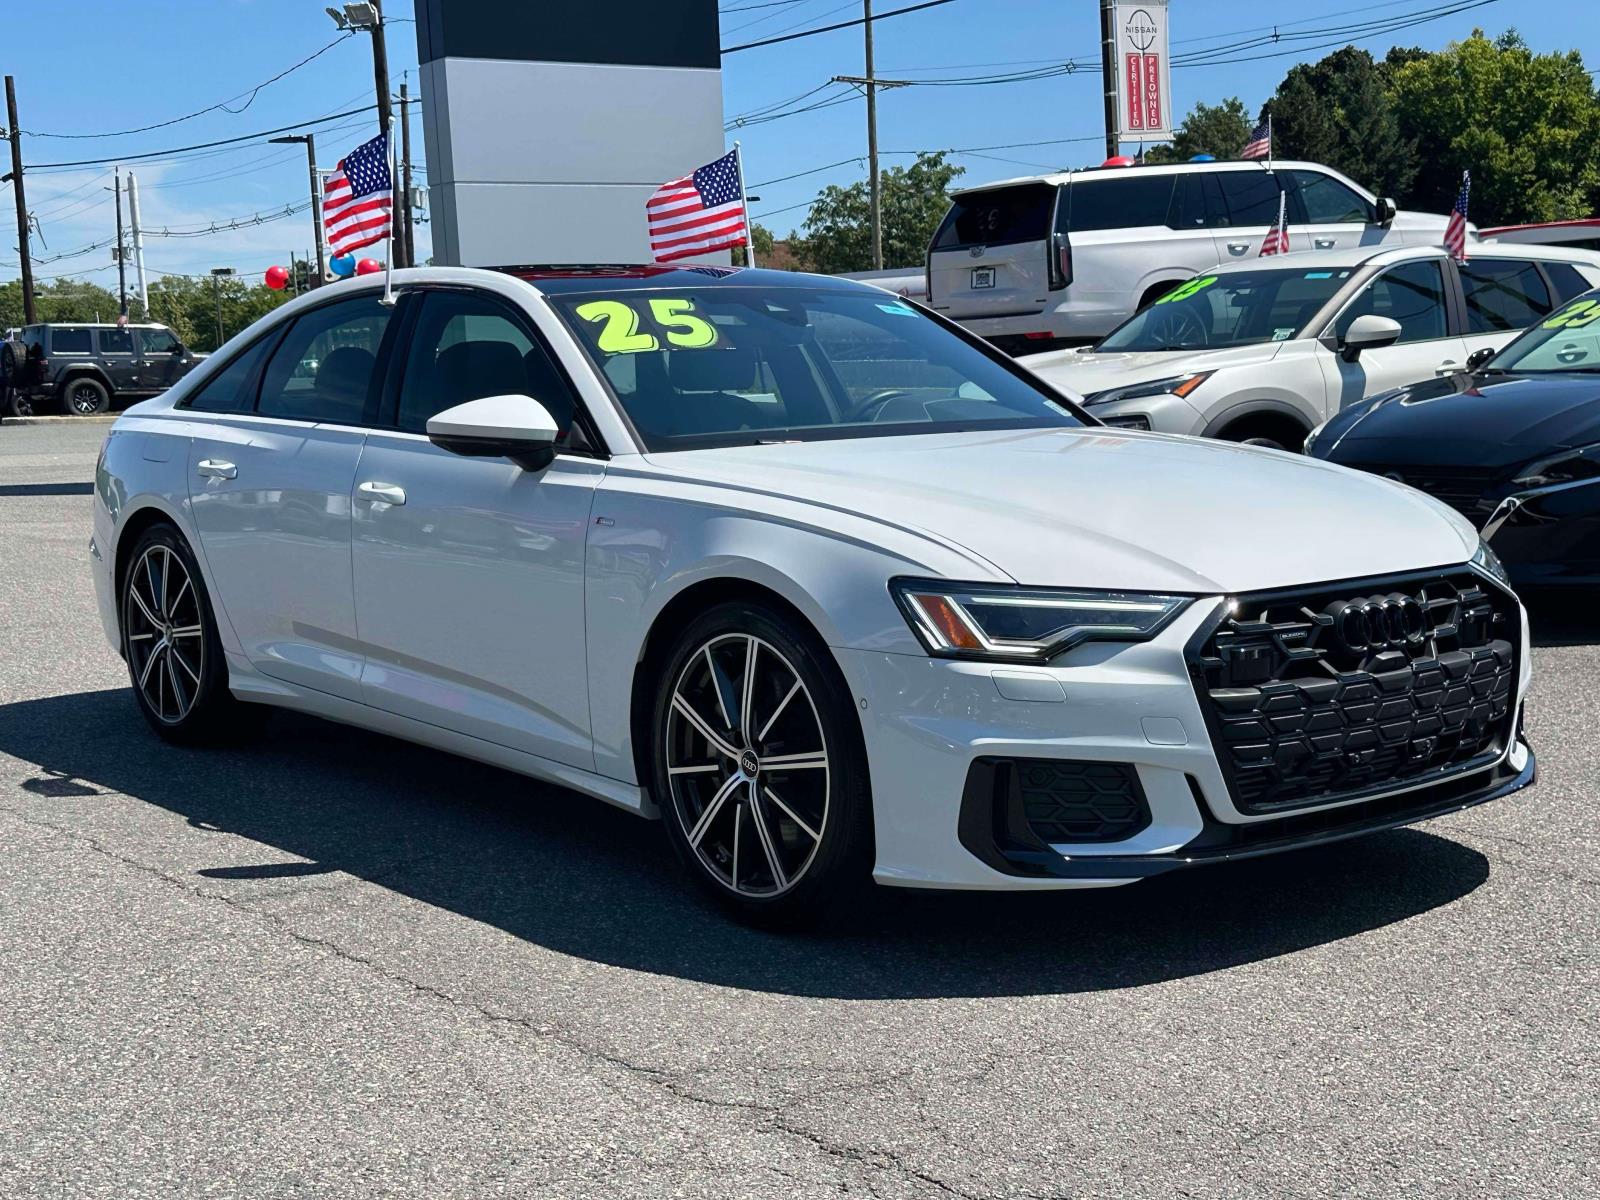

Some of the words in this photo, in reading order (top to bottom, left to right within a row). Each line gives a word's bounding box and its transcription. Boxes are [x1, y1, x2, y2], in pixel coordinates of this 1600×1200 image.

[1125, 26, 1157, 34] NISSAN
[1130, 57, 1140, 127] CERTIFIED
[1148, 57, 1158, 126] PREOWNED
[575, 299, 719, 356] 25
